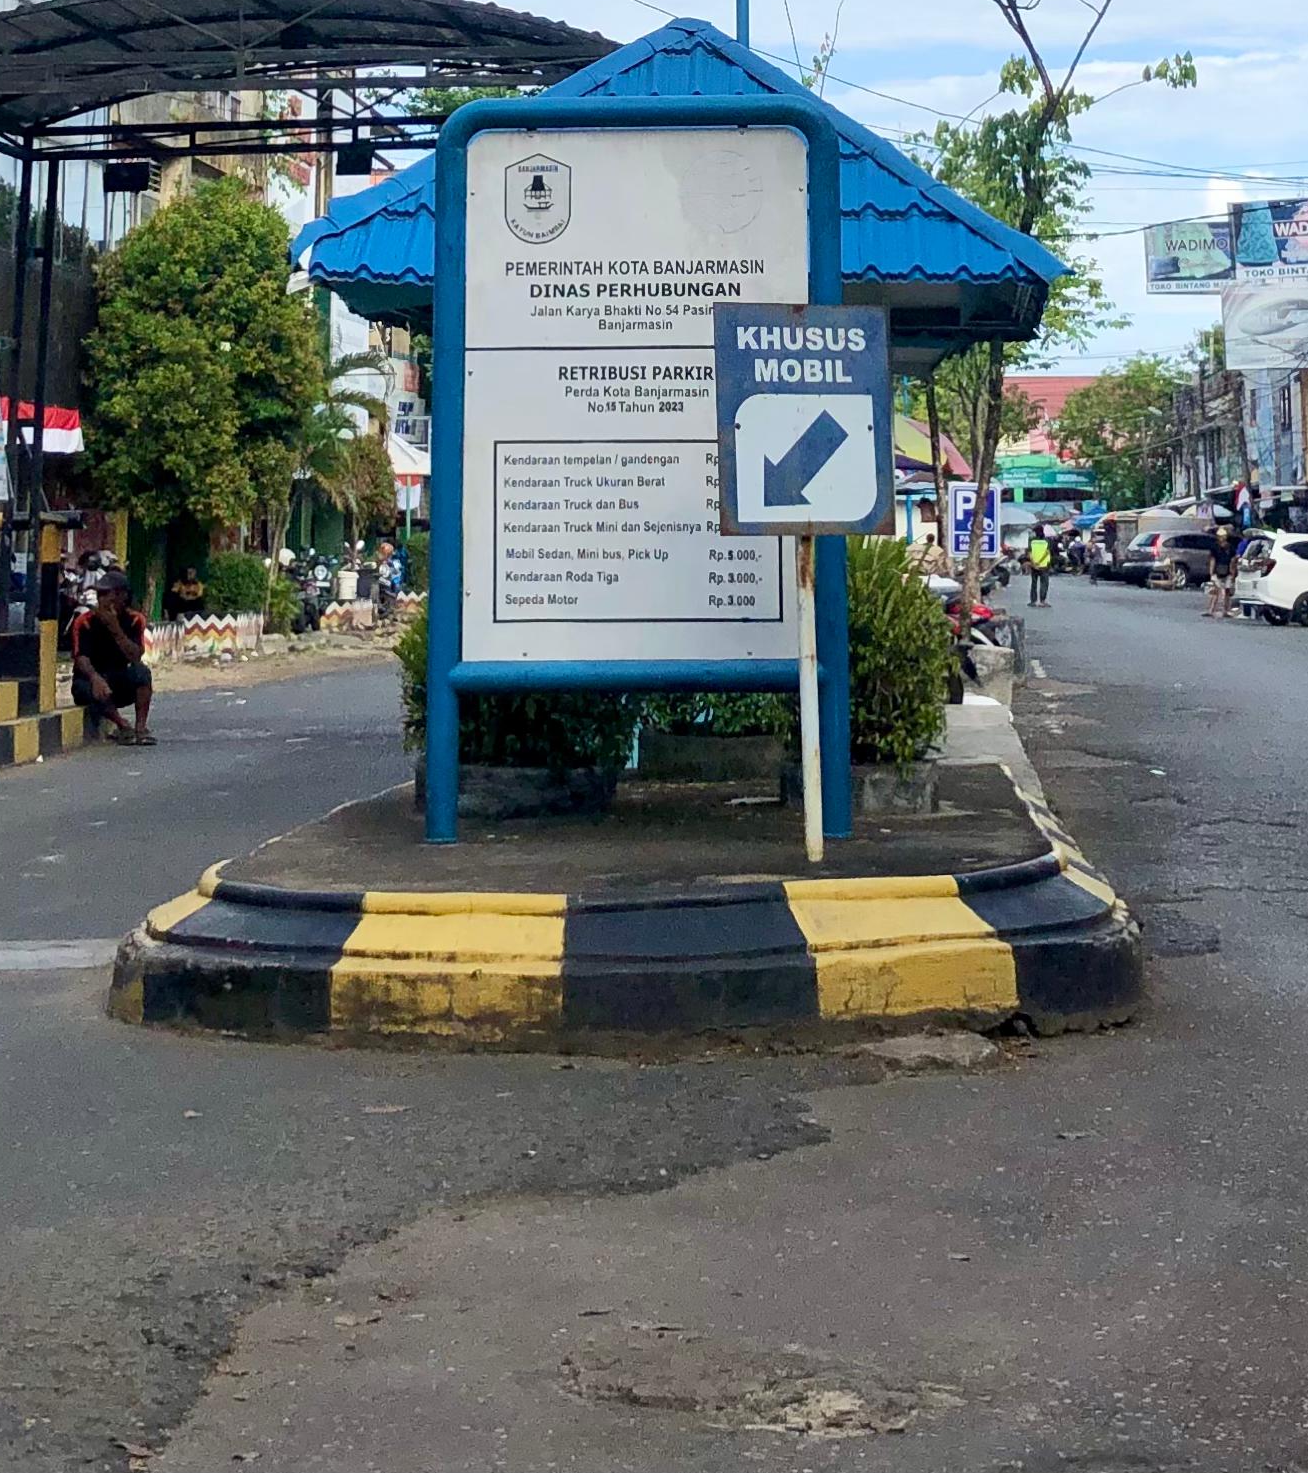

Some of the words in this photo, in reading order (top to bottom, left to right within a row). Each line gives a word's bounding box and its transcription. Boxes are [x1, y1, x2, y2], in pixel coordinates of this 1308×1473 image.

[505, 260, 603, 277] PEMERINTAH
[607, 260, 650, 276] KOTA
[654, 259, 764, 276] BANJARMASIN
[1244, 268, 1274, 278] TOKO
[529, 283, 591, 299] DINAS
[596, 282, 742, 298] PERHUBUNGAN
[530, 304, 563, 317] Jalan
[565, 304, 599, 321] Karya
[601, 303, 641, 317] Bhakti
[645, 304, 662, 317] No
[665, 304, 680, 316] 54
[598, 318, 673, 332] Banjarmasin
[736, 326, 867, 352] KHUSUS
[558, 366, 647, 382] RETRIBUSI
[652, 366, 714, 381] PARKIR
[754, 358, 853, 384] MOBIL
[565, 385, 599, 399] Perda
[603, 385, 630, 398] Kota
[634, 385, 710, 400] Banjarmasin
[619, 401, 655, 413] Tahun
[503, 455, 560, 466] Kendaraan
[563, 455, 612, 467] tempelan
[621, 453, 680, 468] gandengan
[503, 477, 560, 488] Kendaraan
[563, 476, 593, 488] Truck
[596, 476, 634, 487] Ukuran
[636, 476, 666, 487] Berat
[503, 499, 560, 511] Kendaraan
[563, 499, 593, 510] Truck
[595, 498, 615, 510] dan
[618, 498, 639, 510] Bus
[956, 491, 978, 521] P
[503, 521, 560, 533] Kendaraan
[563, 521, 593, 533] Truck
[596, 521, 618, 532] Mini
[621, 521, 640, 532] dan
[643, 520, 702, 535] Sejenisnya
[505, 548, 535, 559] Mobil
[537, 548, 574, 560] Sedan,
[577, 548, 599, 559] Mini
[602, 548, 625, 561] bus,
[628, 548, 651, 559] Pick
[654, 549, 669, 562] Up
[505, 571, 562, 582] Kendaraan
[565, 571, 594, 582] Roda
[596, 571, 619, 585] Tiga
[505, 594, 544, 607] Sepeda
[547, 593, 579, 605] Motor
